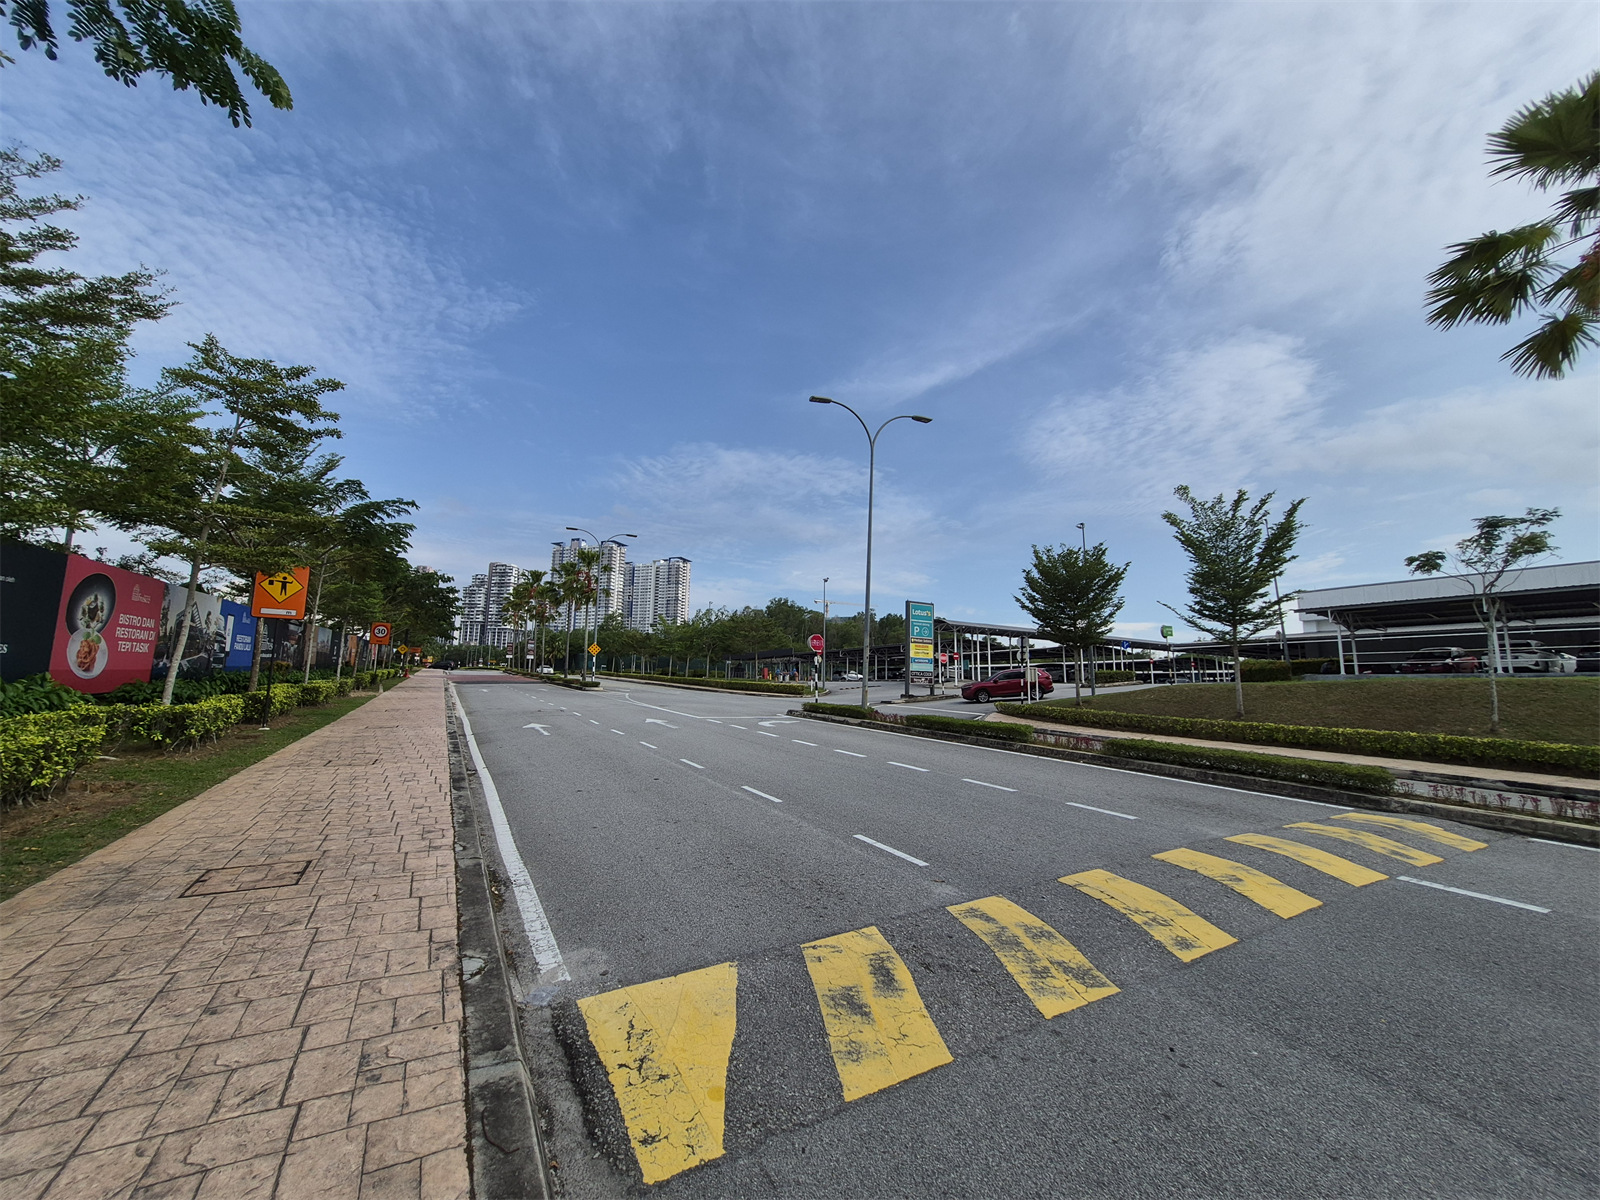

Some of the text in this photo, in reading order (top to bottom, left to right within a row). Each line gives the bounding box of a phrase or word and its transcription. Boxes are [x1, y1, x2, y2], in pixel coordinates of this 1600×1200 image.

[912, 609, 931, 617] Lotus's
[119, 613, 155, 628] BISTRO DAN
[115, 627, 156, 640] RESTORAN DI
[376, 627, 386, 635] 30
[914, 626, 920, 635] P
[118, 641, 149, 653] TEPI TASIK
